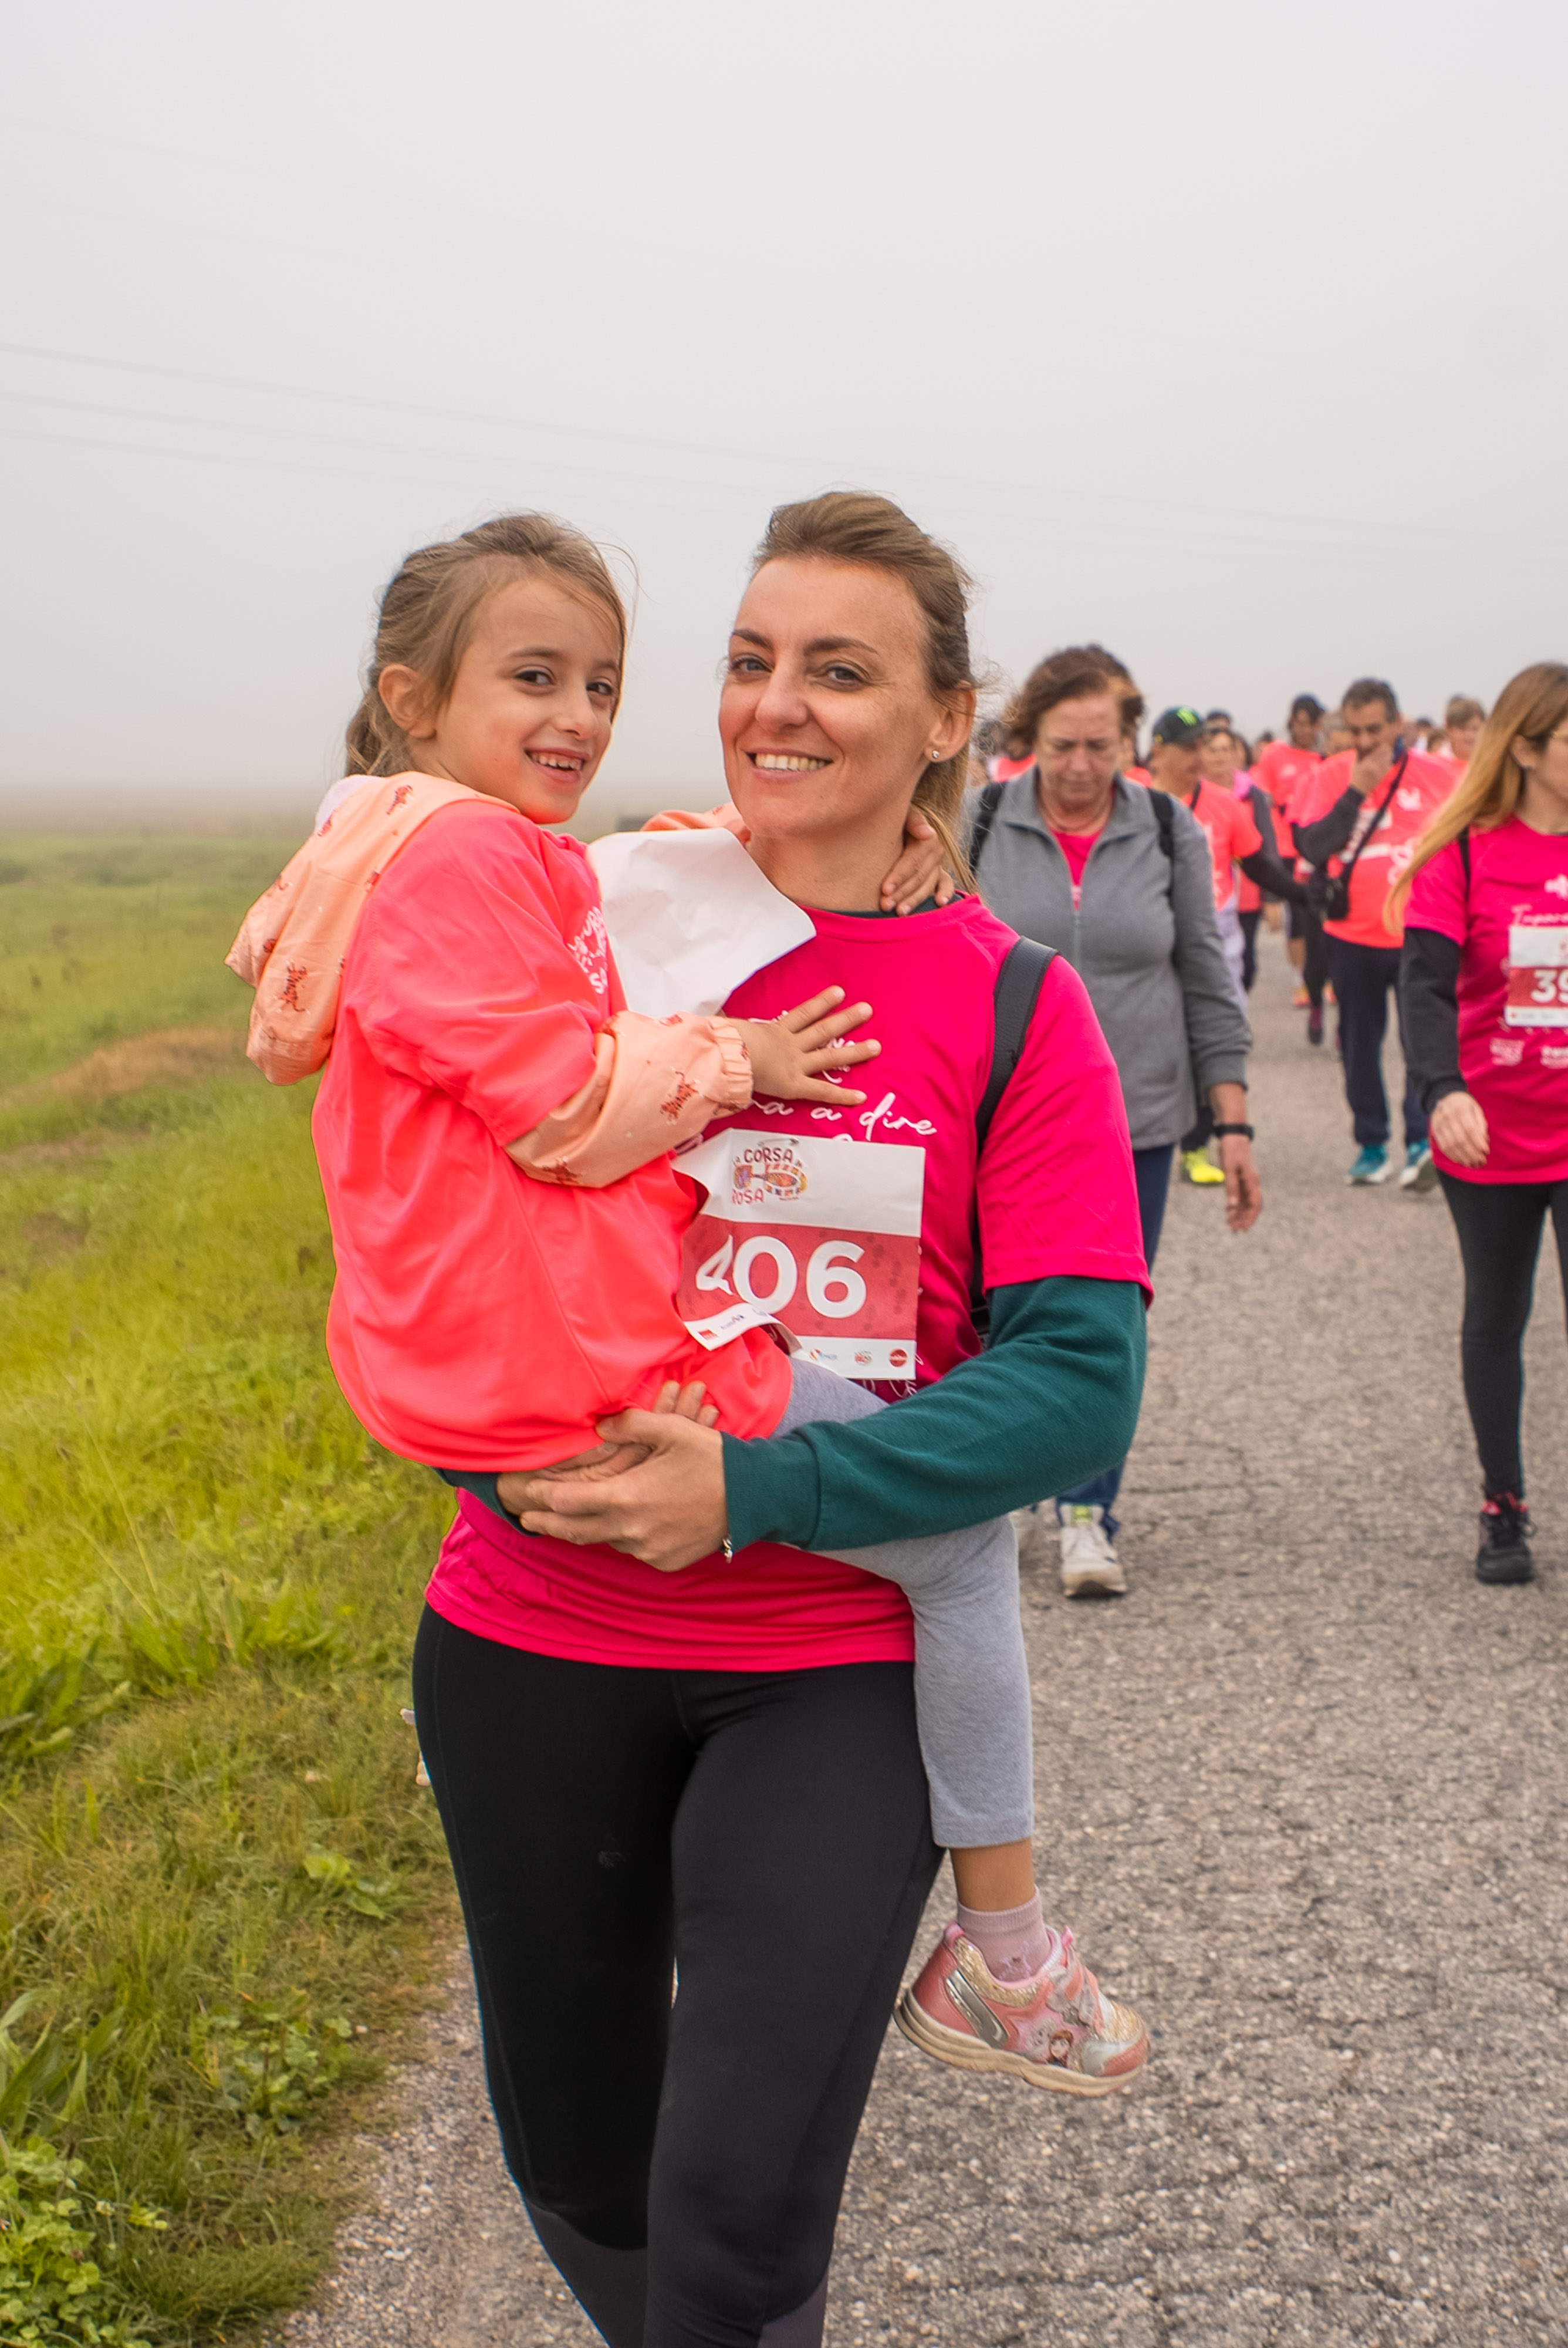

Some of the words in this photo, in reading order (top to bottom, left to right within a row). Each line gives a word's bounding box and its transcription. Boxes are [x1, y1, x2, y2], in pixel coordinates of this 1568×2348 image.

[810, 1107, 843, 1121] a
[859, 1092, 938, 1141] dire
[744, 1146, 793, 1163] CORSA
[731, 1188, 765, 1205] ROSA
[695, 1234, 867, 1319] 406
